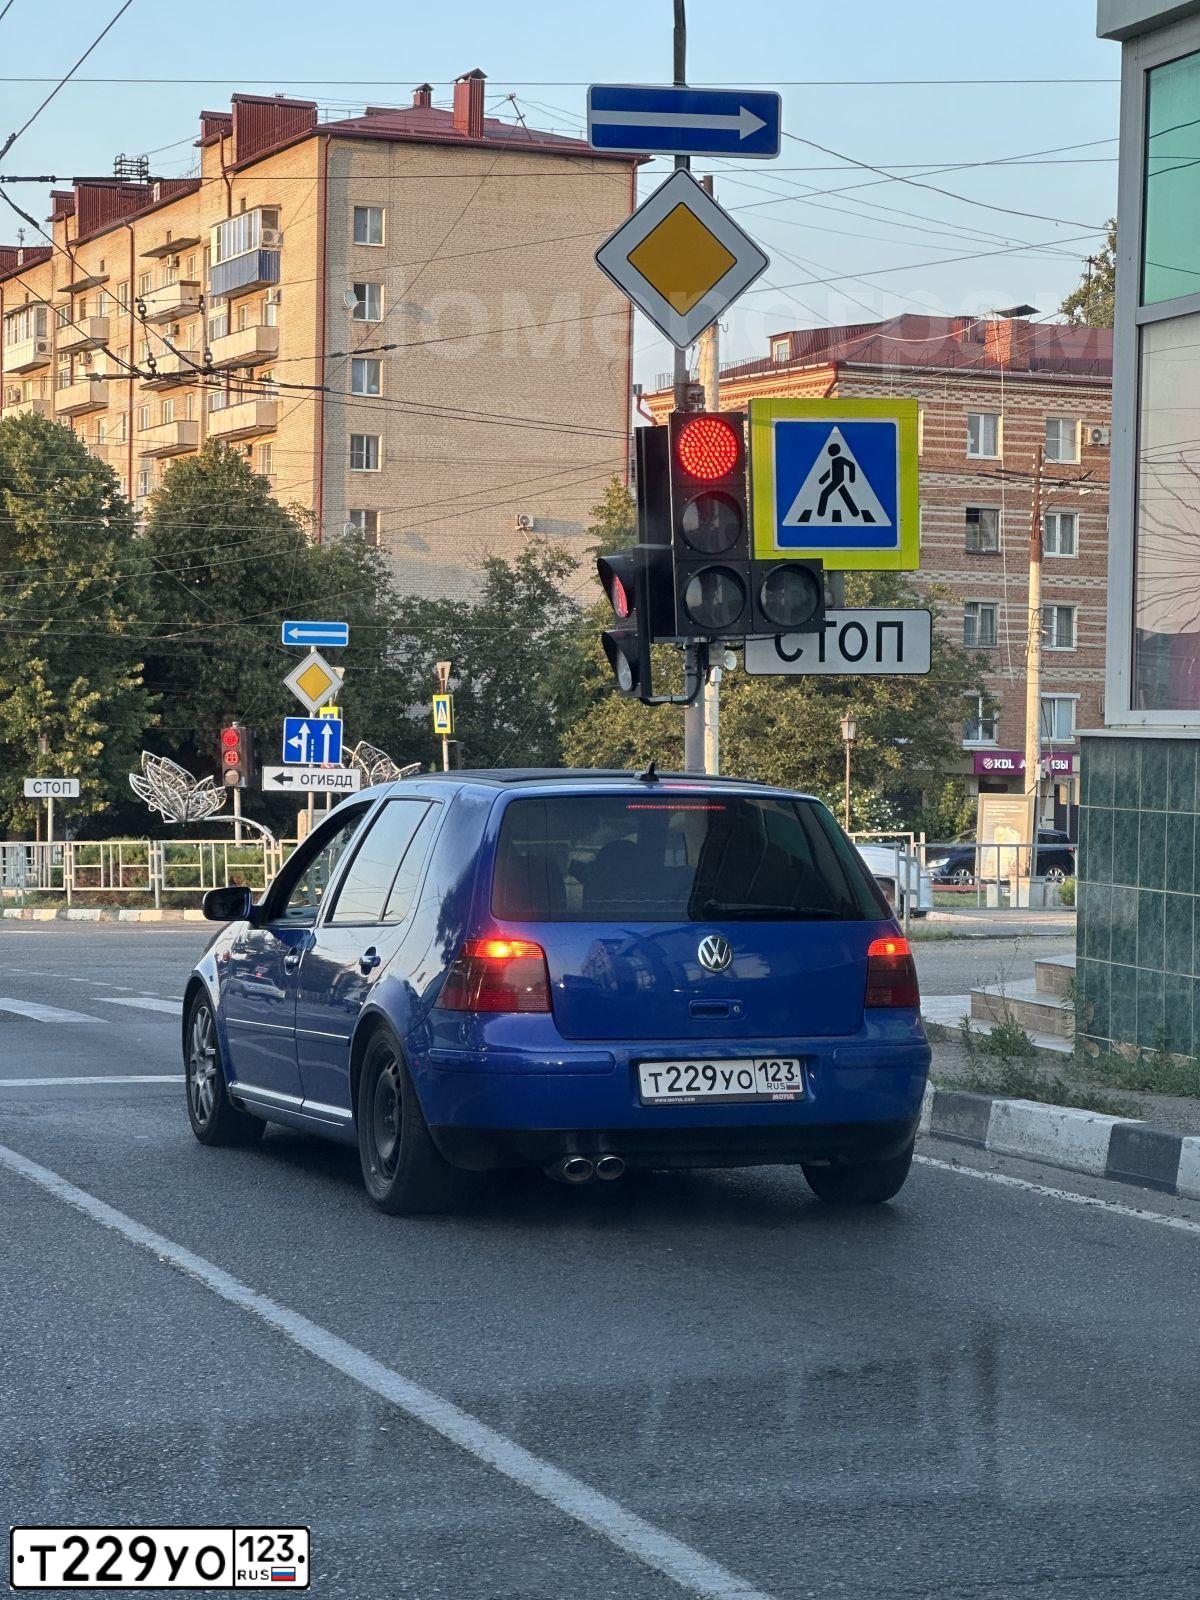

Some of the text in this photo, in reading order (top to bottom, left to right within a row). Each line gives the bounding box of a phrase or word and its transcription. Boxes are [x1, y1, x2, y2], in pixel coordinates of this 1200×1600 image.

[774, 621, 904, 662] СТОП
[994, 759, 1014, 769] KDL
[300, 774, 352, 787] ОГИБДД
[33, 782, 71, 794] СТОП
[649, 1061, 795, 1093] Т229УО 123
[767, 1082, 785, 1090] RUS
